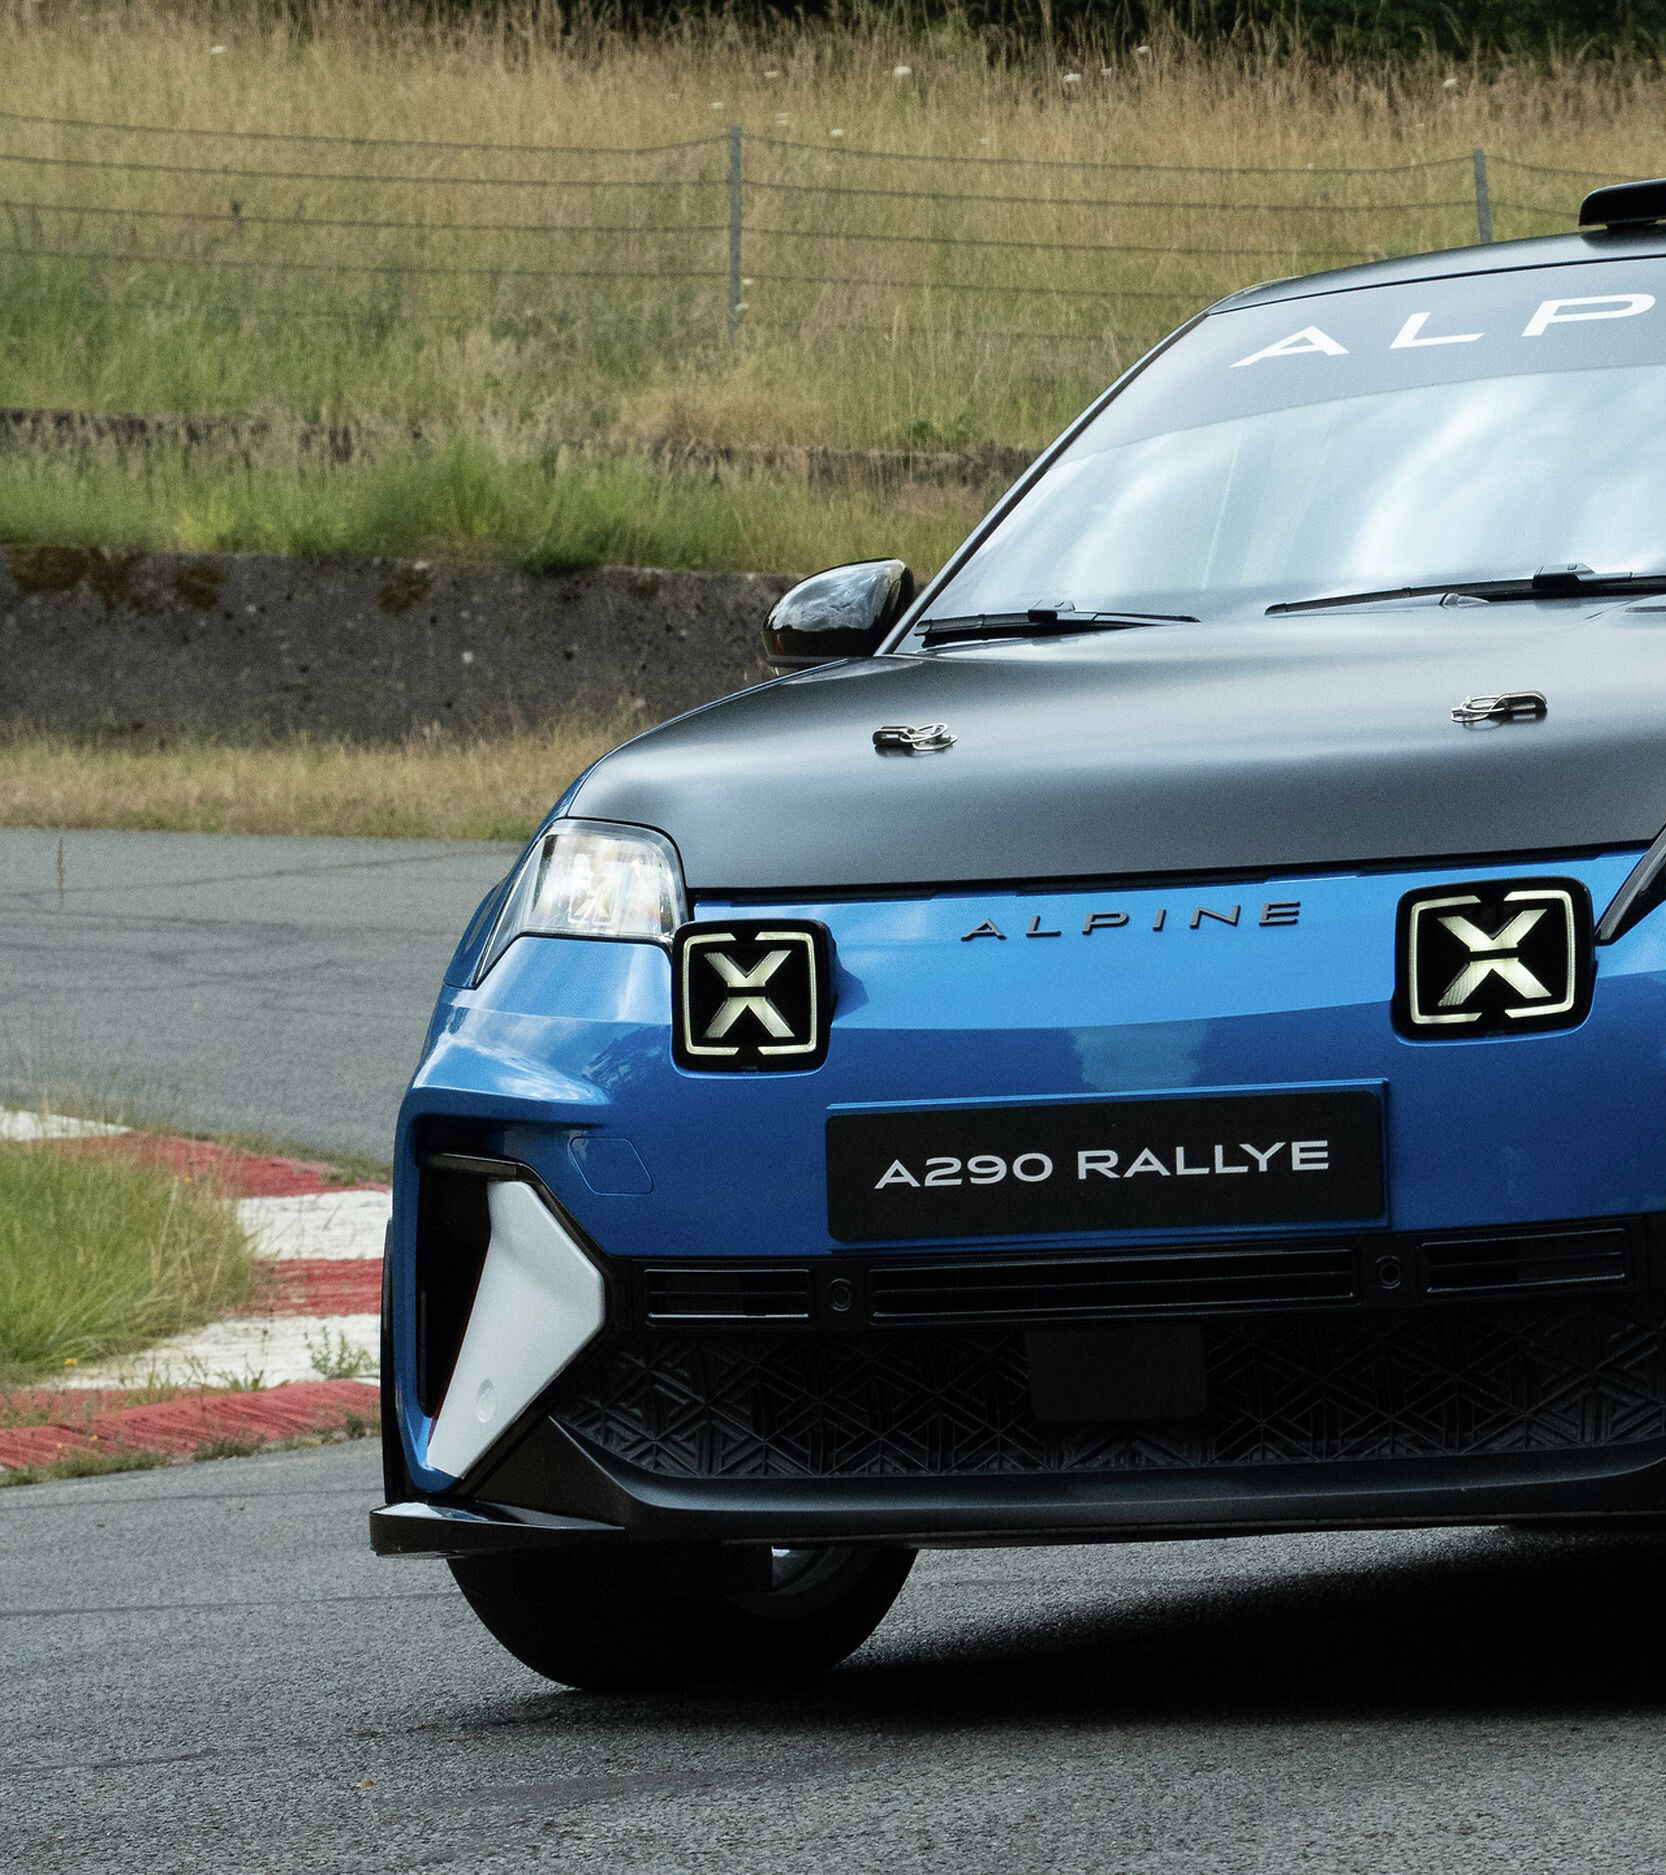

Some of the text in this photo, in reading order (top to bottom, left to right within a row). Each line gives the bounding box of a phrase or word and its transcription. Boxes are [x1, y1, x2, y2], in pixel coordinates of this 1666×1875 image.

[960, 901, 1301, 942] ALPINE
[874, 1140, 1329, 1190] A290 RALLYE
